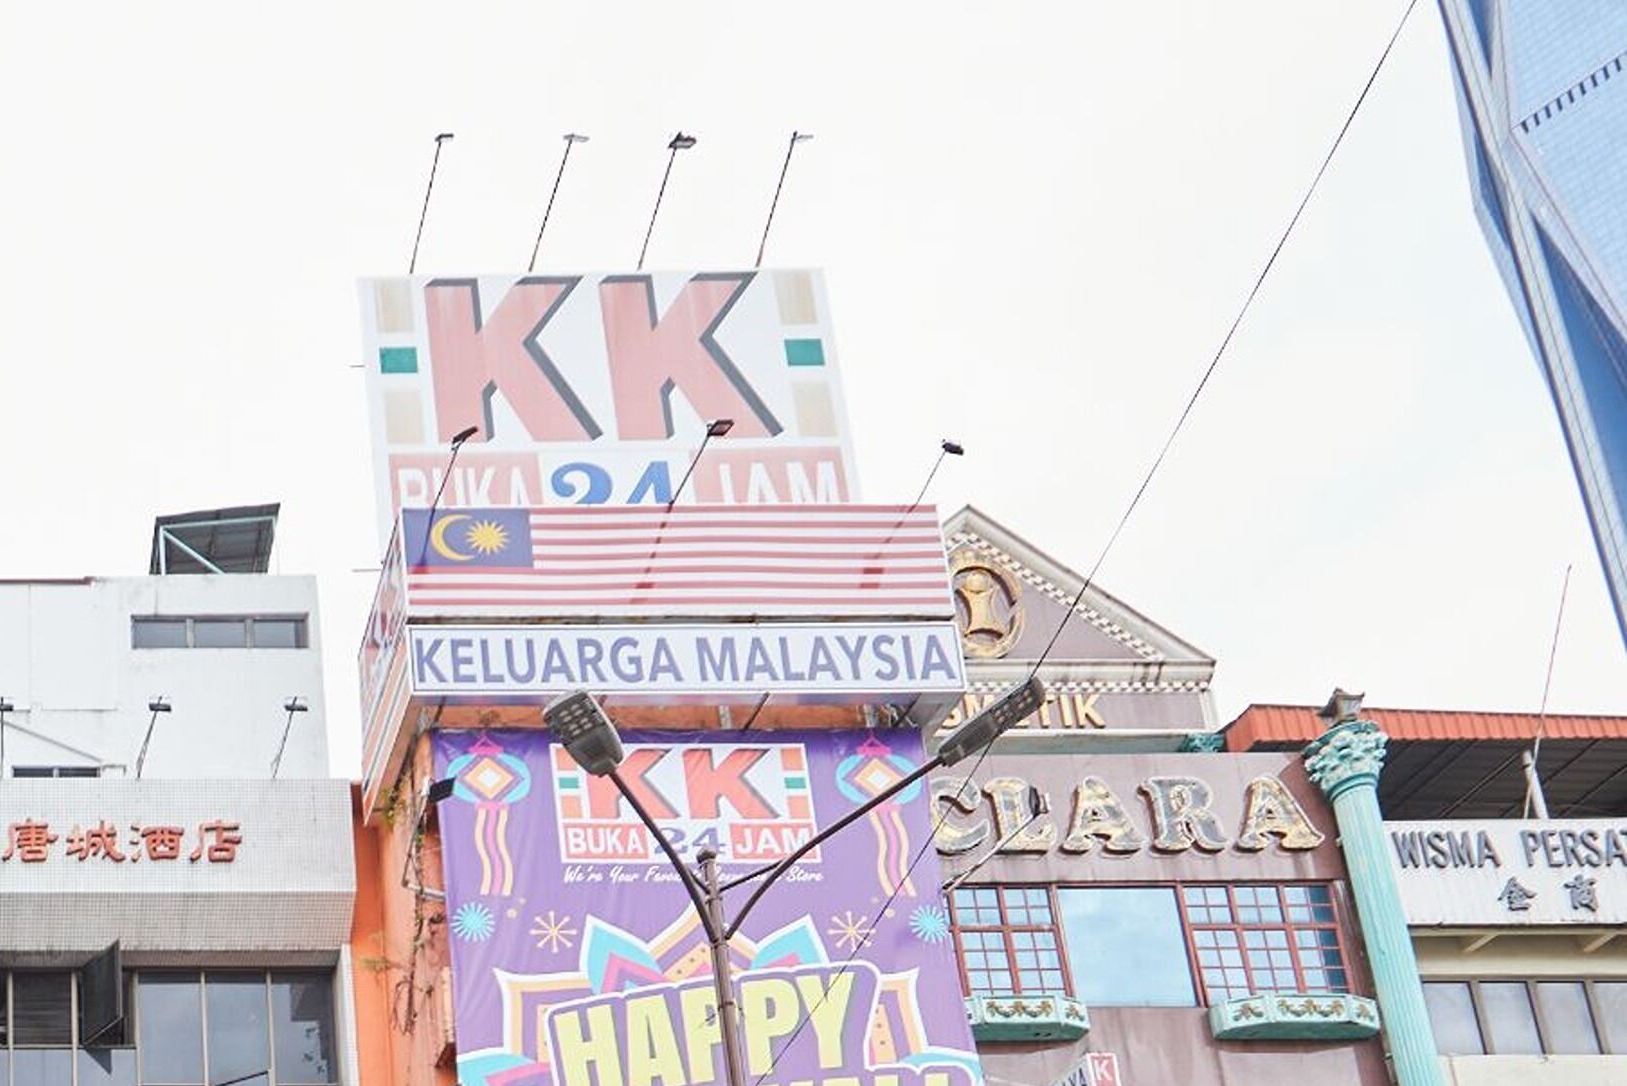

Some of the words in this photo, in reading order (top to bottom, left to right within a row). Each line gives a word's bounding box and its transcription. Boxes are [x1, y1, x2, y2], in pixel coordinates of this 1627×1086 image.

[424, 271, 784, 444] KK
[415, 636, 684, 685] KELUARGA
[697, 634, 957, 683] MALAYSIA
[585, 748, 781, 820] KK
[931, 775, 1325, 857] CLARA
[1, 817, 244, 865] 唐城酒店
[566, 827, 643, 854] BUKA
[654, 826, 726, 856] 24
[736, 828, 810, 854] JAM
[1391, 829, 1502, 869] WISMA
[610, 866, 639, 884] Your
[787, 864, 824, 884] Store
